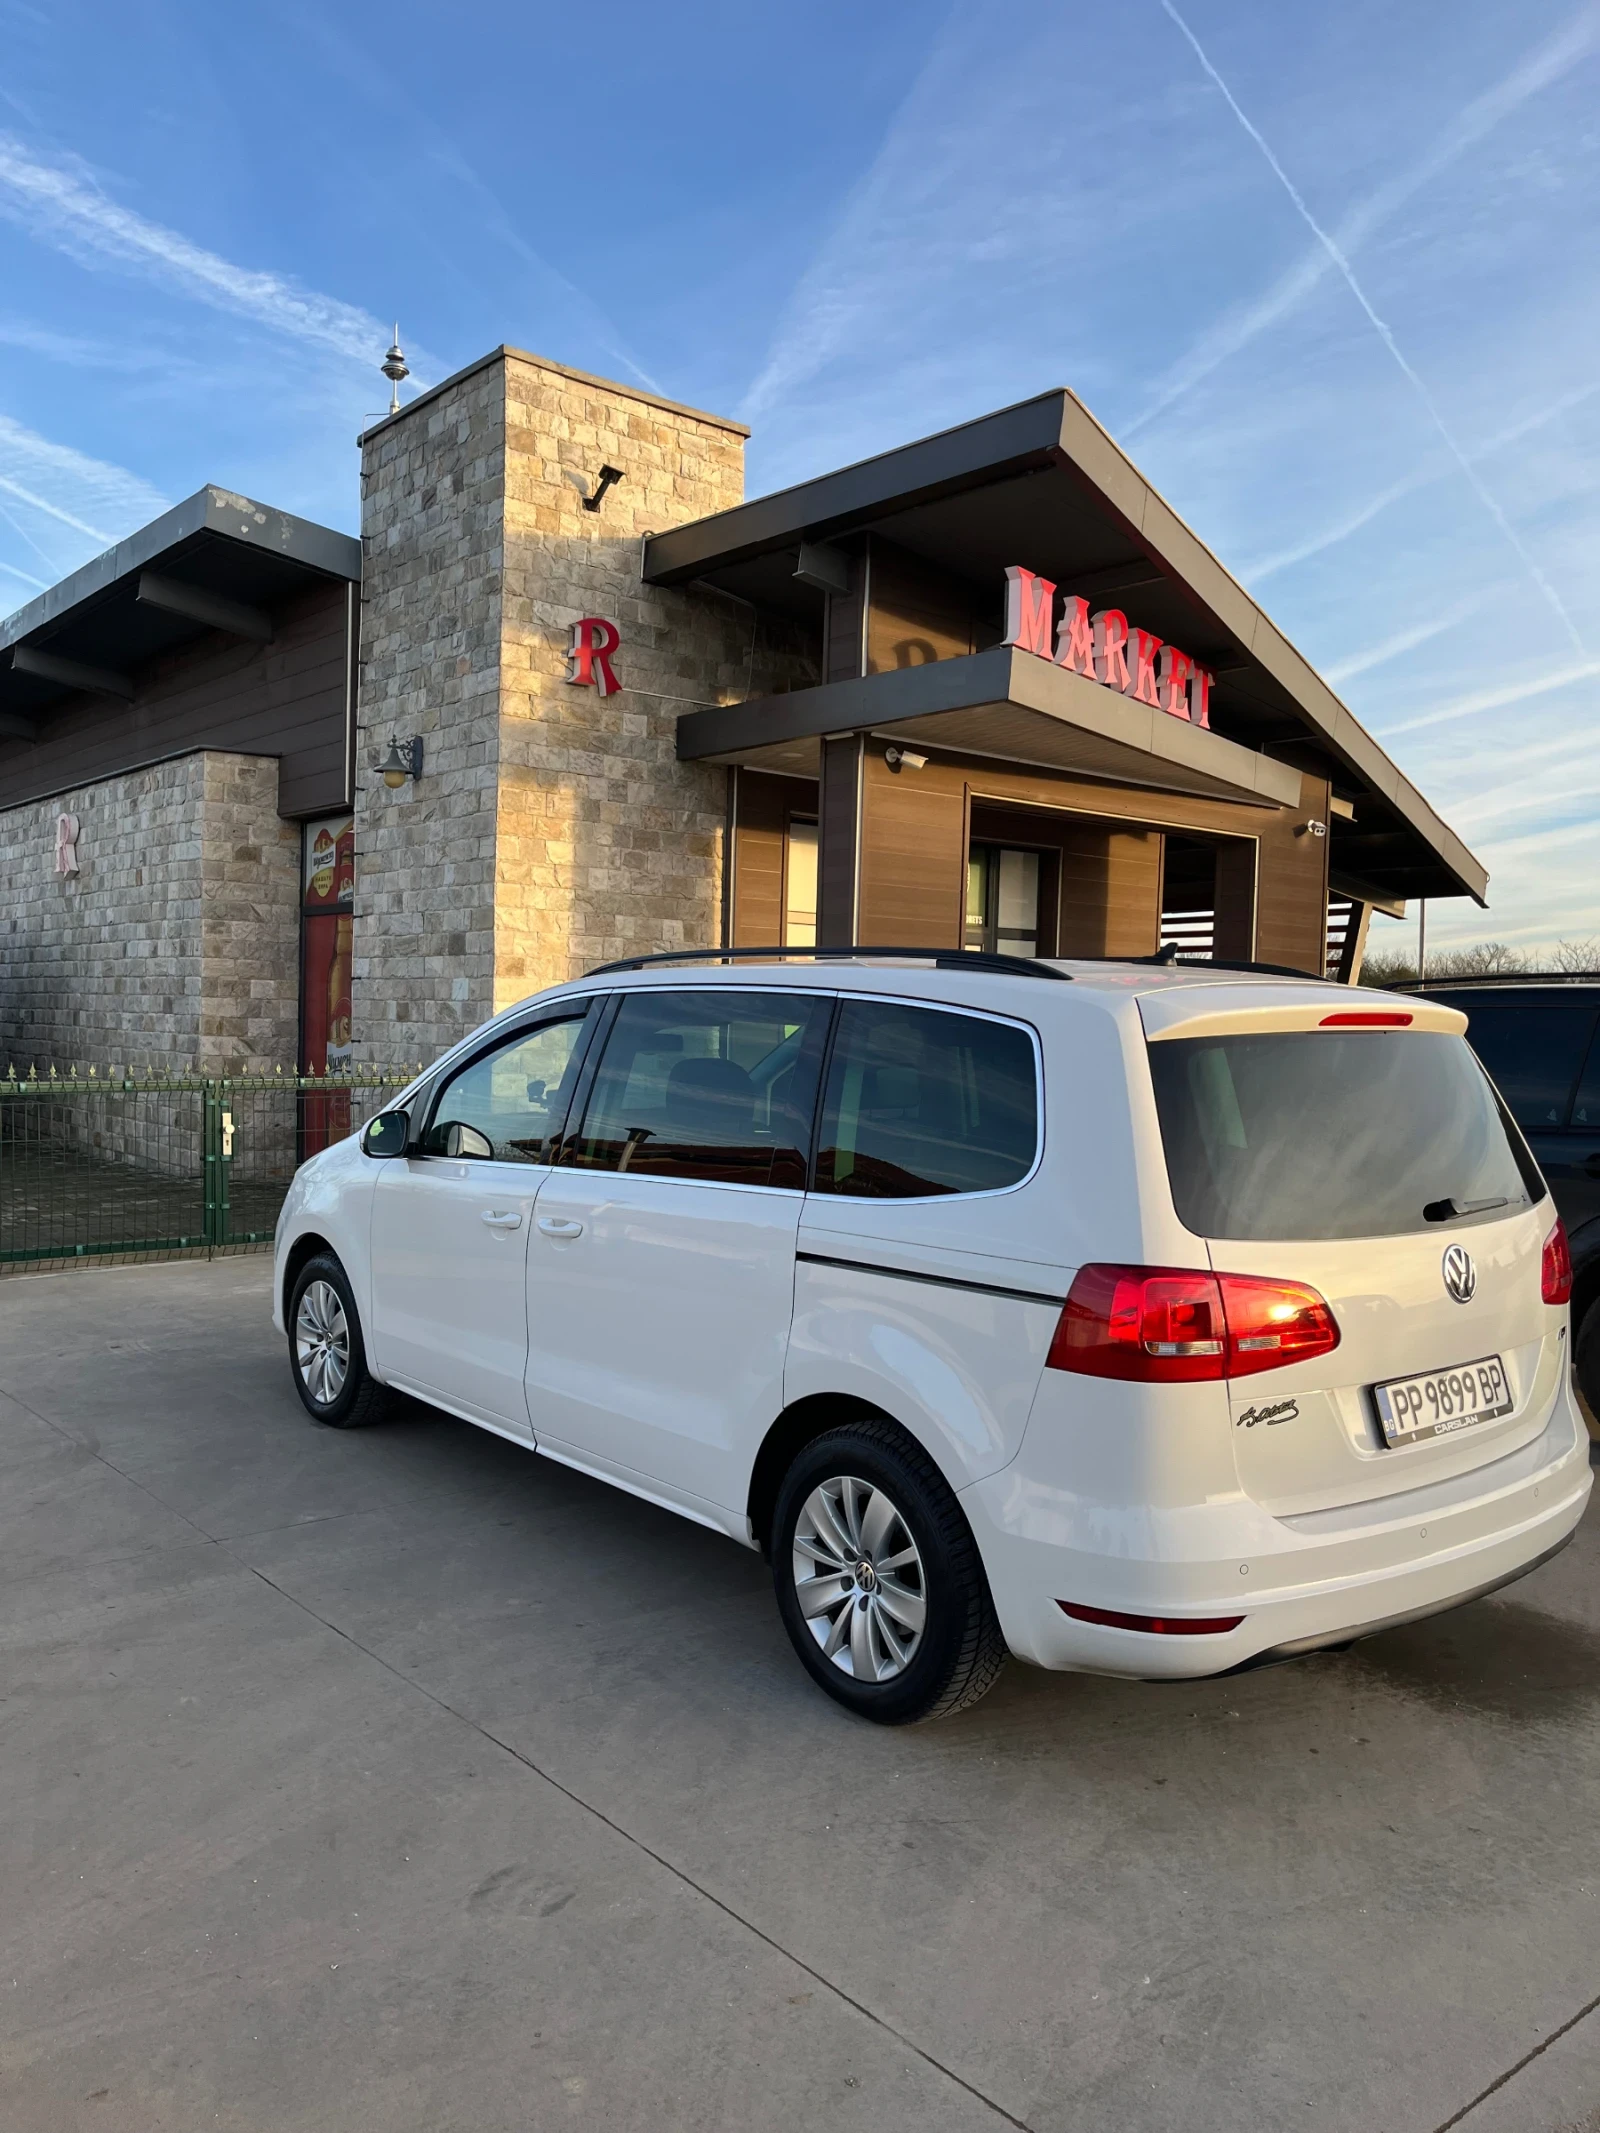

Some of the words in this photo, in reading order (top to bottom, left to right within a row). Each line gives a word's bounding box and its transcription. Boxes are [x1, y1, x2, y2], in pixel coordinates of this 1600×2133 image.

[567, 618, 623, 696] R
[1000, 565, 1215, 729] MARKET
[1425, 1371, 1477, 1419] 9899
[1384, 1419, 1395, 1431] BG
[1434, 1415, 1478, 1434] CARSLAN
